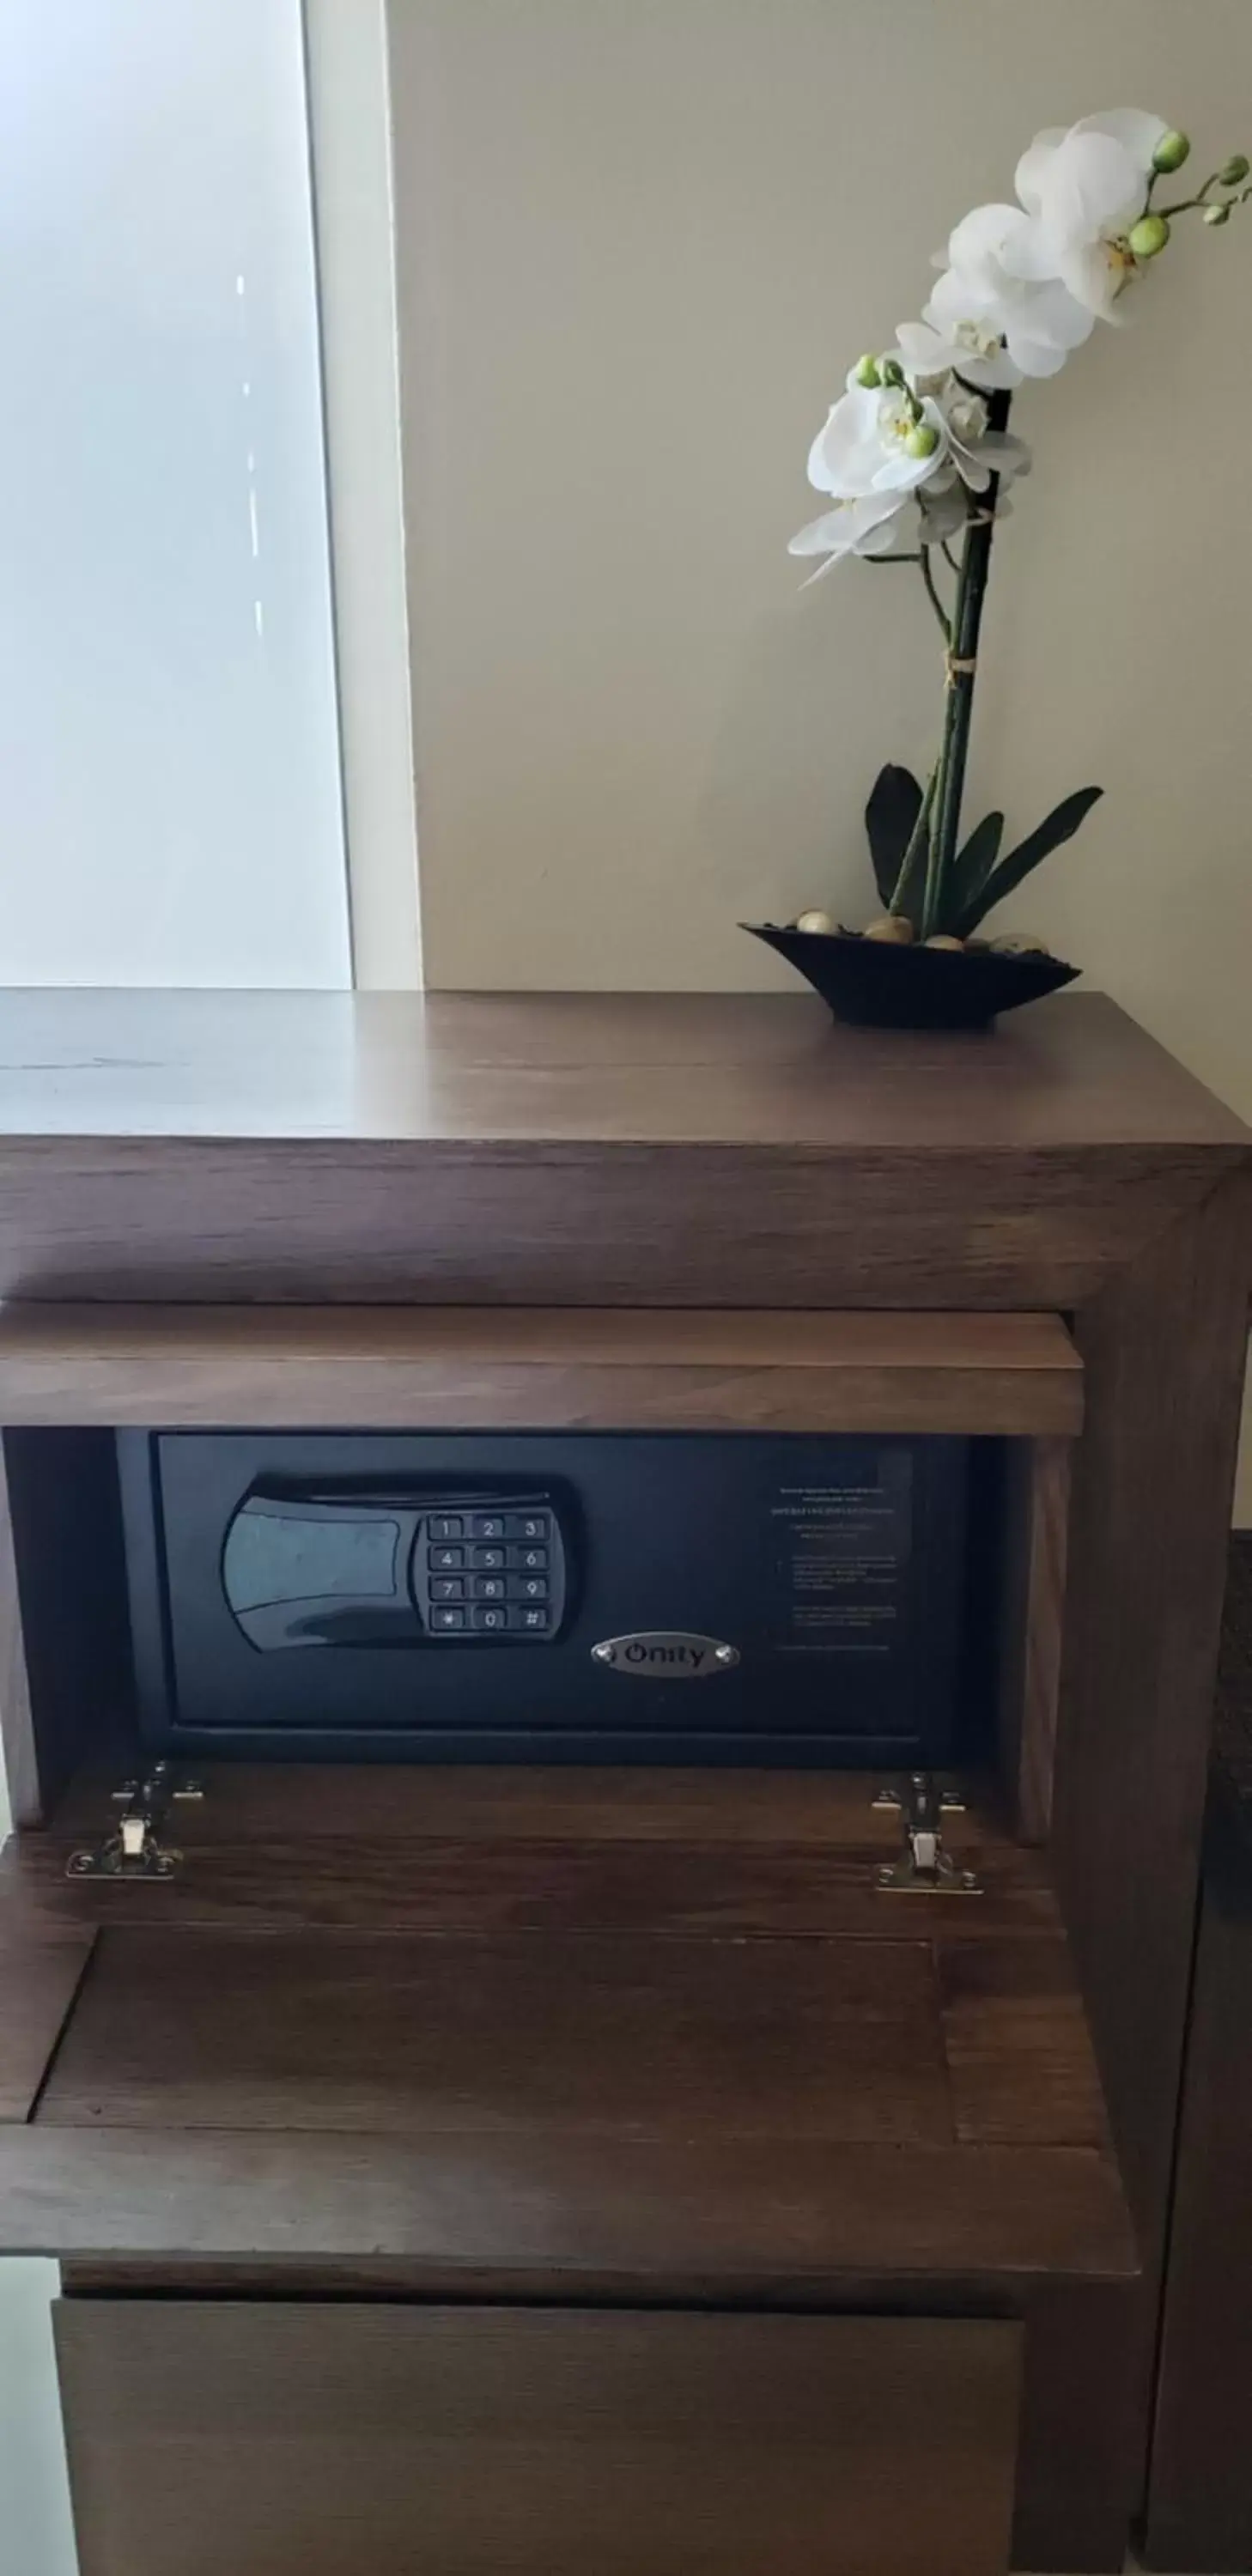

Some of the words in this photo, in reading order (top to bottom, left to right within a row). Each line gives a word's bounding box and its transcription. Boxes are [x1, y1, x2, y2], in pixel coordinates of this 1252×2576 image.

[443, 1521, 449, 1535] 1
[483, 1522, 495, 1536] 2
[525, 1522, 536, 1536] 3
[441, 1552, 453, 1564] 4
[484, 1552, 495, 1566] 5
[526, 1552, 537, 1565] 6
[442, 1583, 453, 1595] 7
[485, 1582, 495, 1595] 8
[526, 1582, 537, 1595] 9
[485, 1611, 495, 1626] 0
[625, 1643, 704, 1668] Onity
